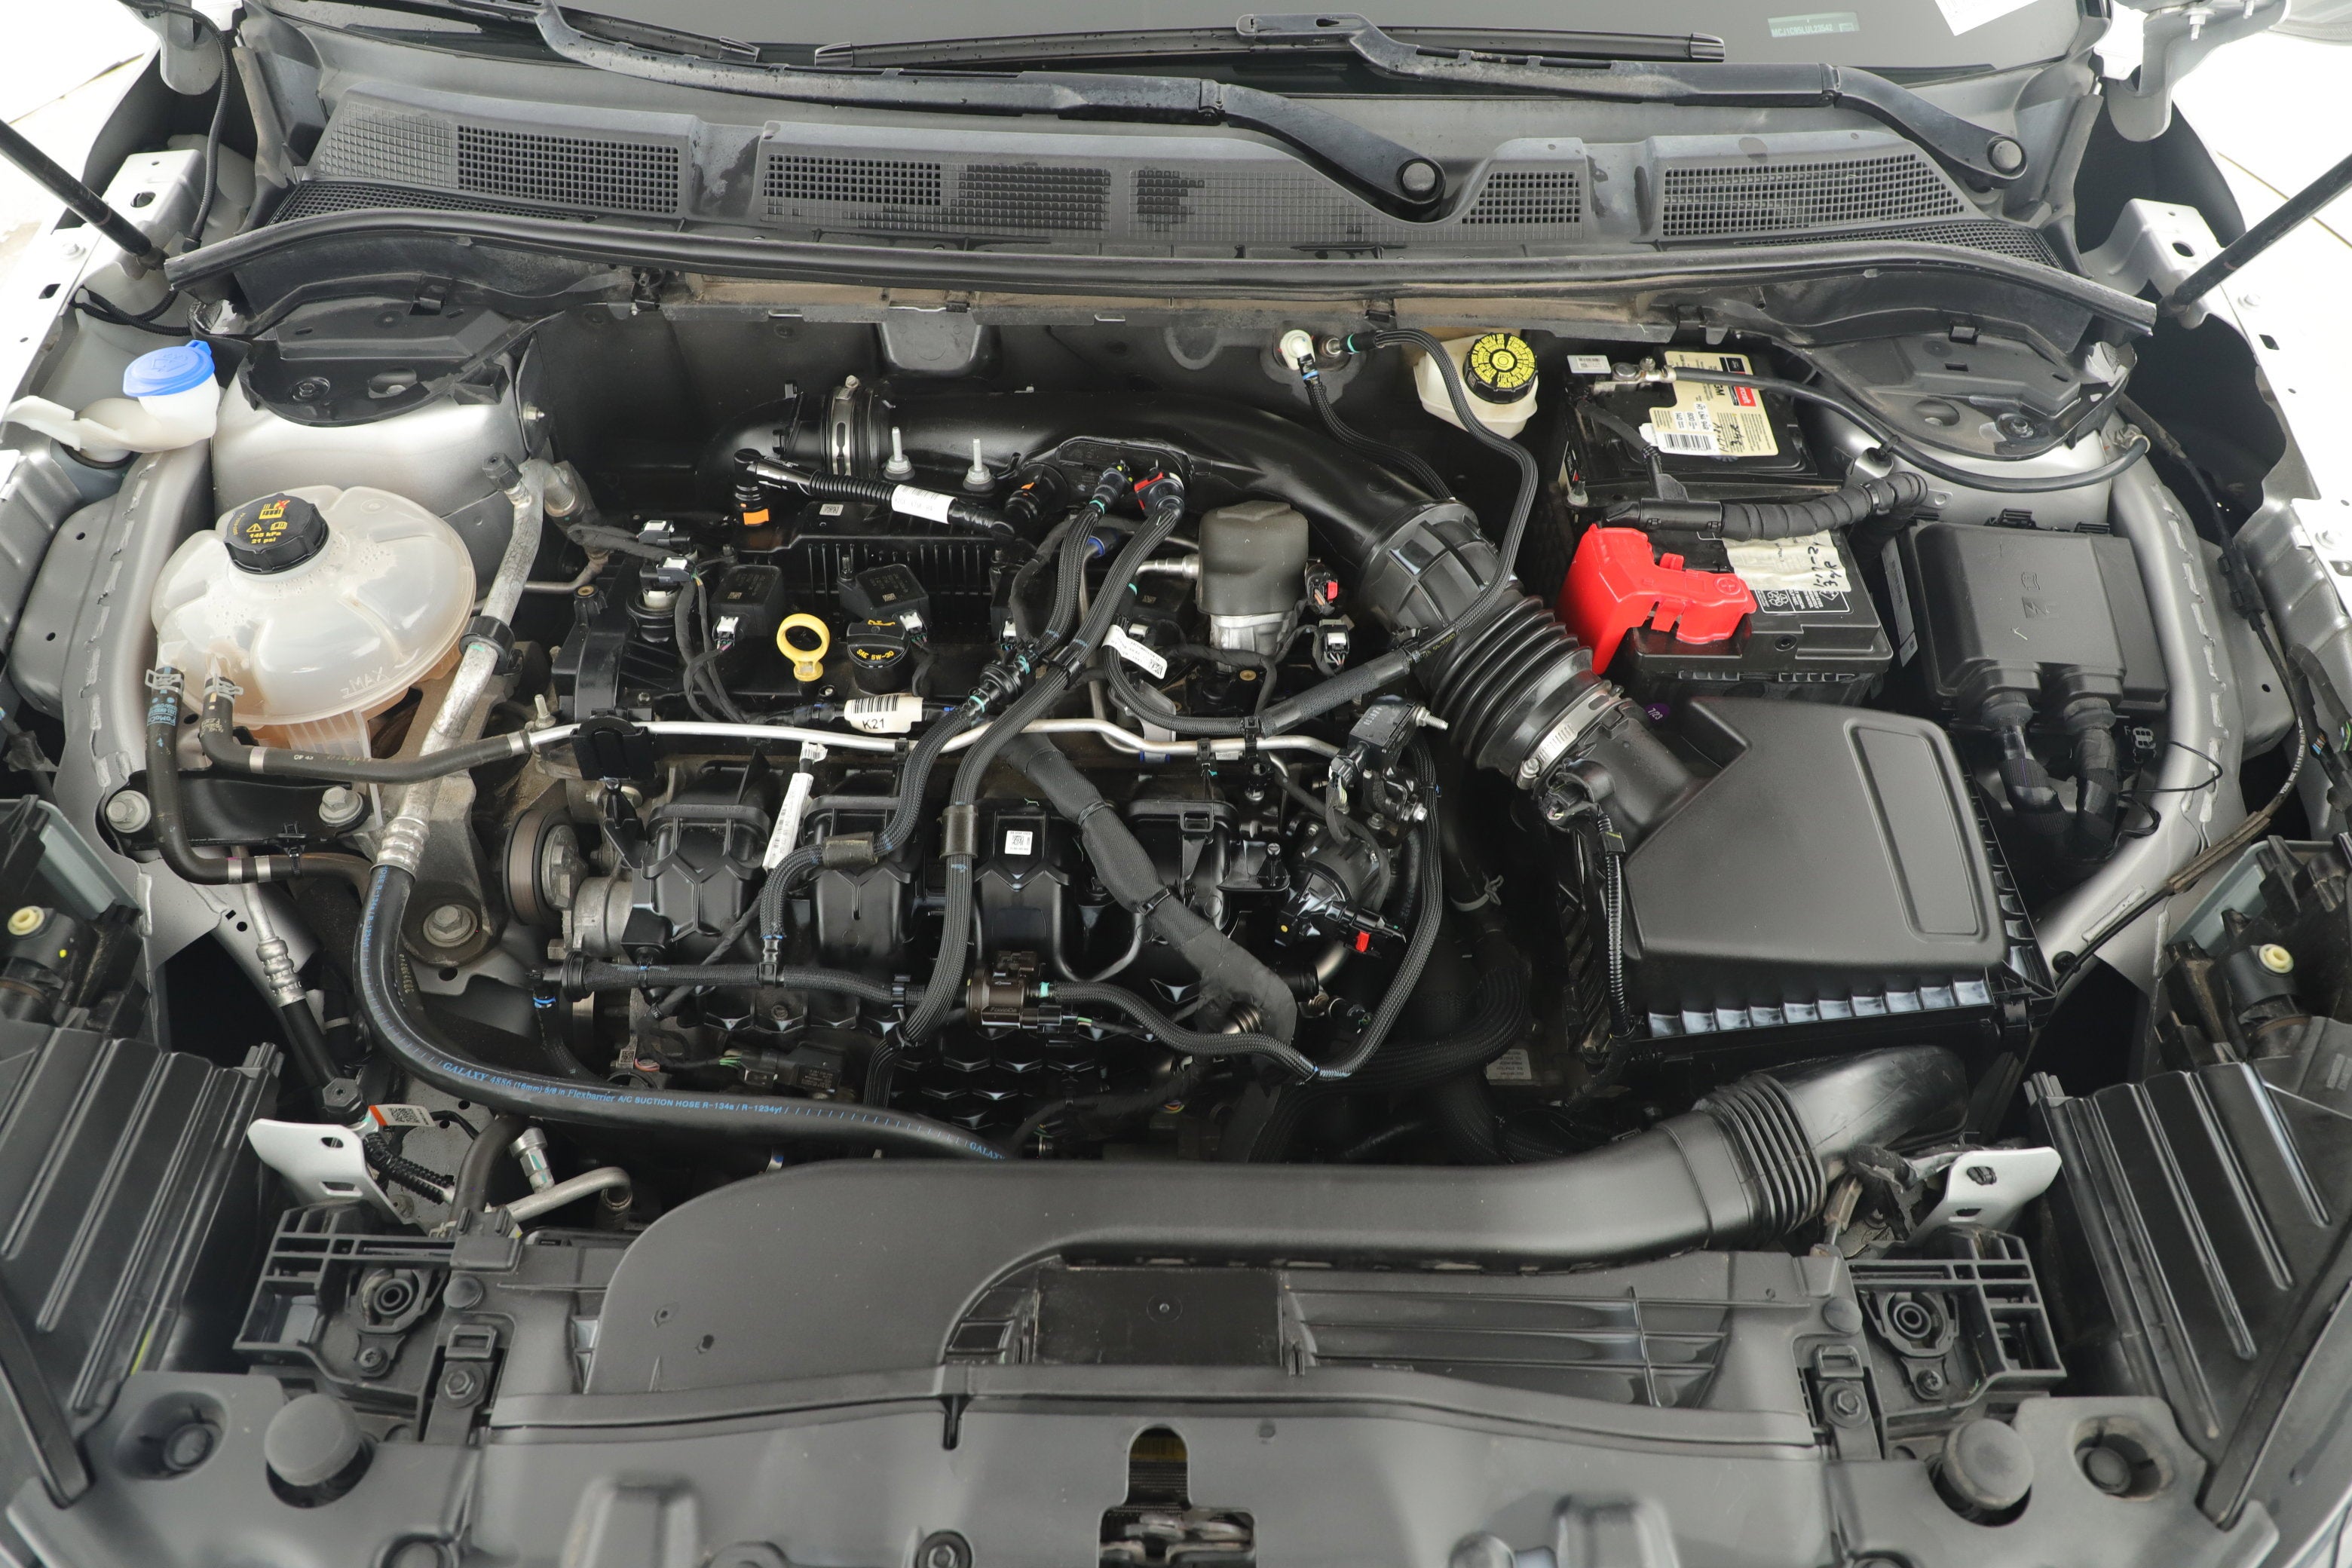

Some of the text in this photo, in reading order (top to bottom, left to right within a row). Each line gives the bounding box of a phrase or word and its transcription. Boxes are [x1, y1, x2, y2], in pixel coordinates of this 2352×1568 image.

[1714, 384, 1726, 396] GM
[856, 648, 895, 660] SAE 5W-30
[349, 666, 390, 691] MAX
[1647, 707, 1663, 720] 7/23
[862, 718, 884, 730] K21
[443, 1061, 489, 1082] GALAXY
[490, 1076, 512, 1089] 4886
[544, 1088, 557, 1096] 5/8
[558, 1088, 565, 1096] in
[567, 1089, 616, 1103] Flexbarrier
[617, 1095, 632, 1104] A/C
[634, 1096, 674, 1107] SUCTION
[702, 1101, 734, 1111] R-134a
[741, 1104, 783, 1114] R-1234yf
